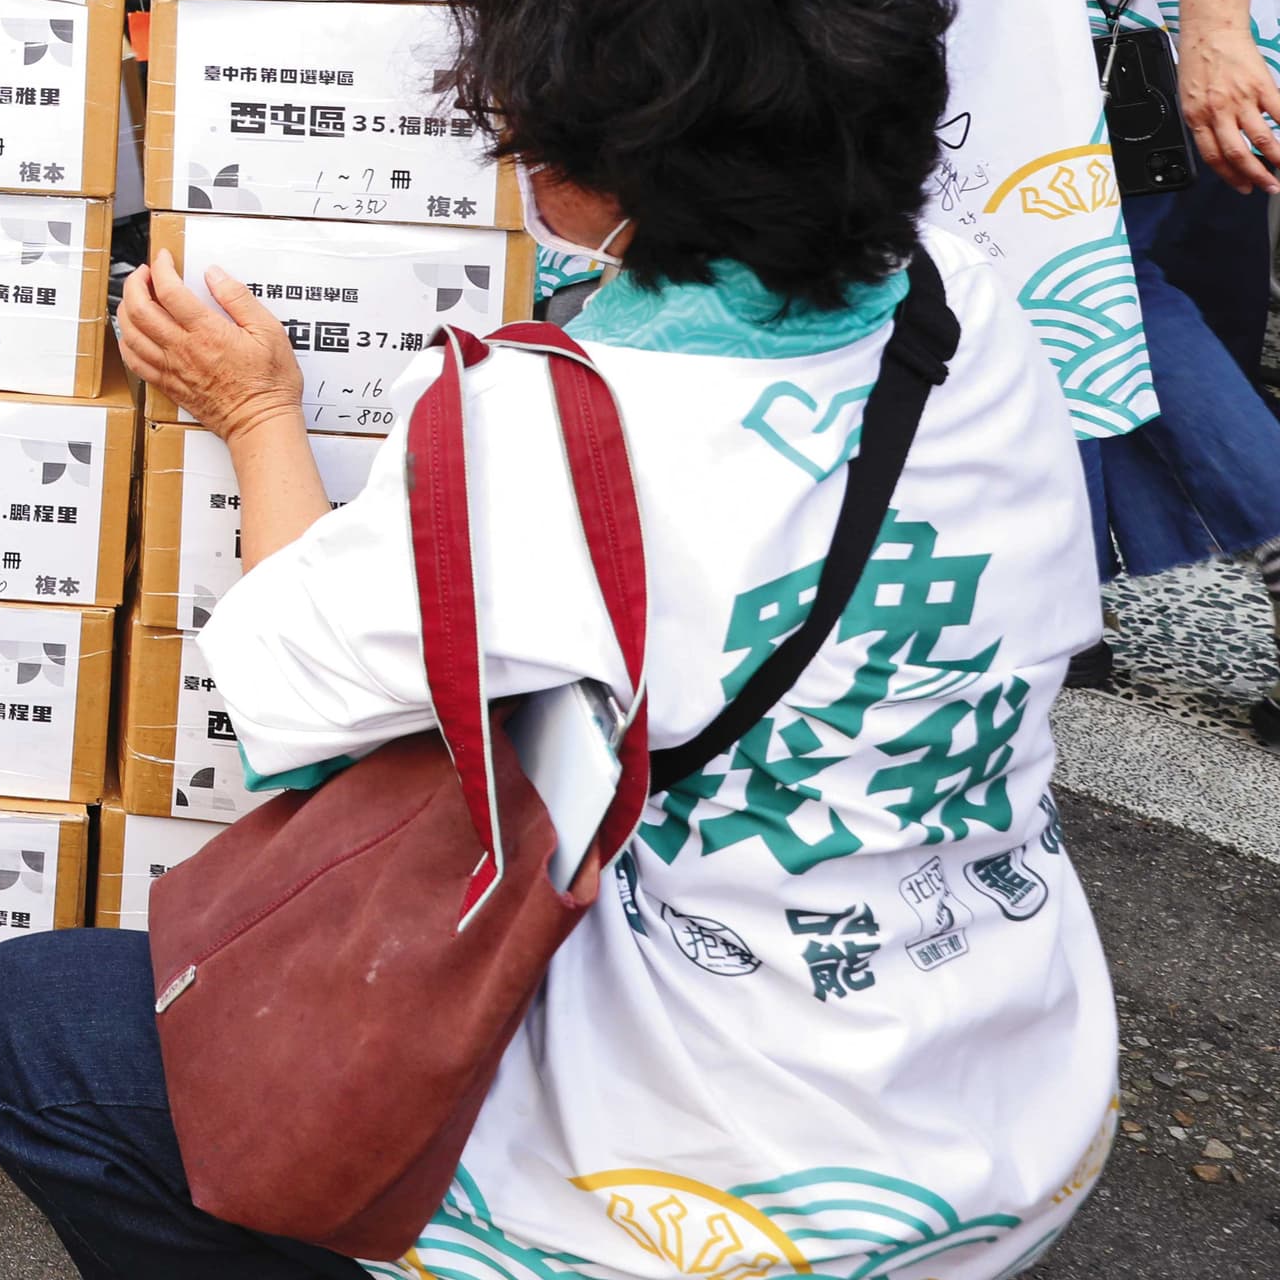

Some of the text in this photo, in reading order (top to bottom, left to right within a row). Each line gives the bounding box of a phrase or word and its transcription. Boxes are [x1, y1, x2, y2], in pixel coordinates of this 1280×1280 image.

[204, 65, 354, 87] 臺中市第四選舉區
[19, 161, 65, 184] 複本
[427, 195, 477, 219] 複本
[35, 575, 80, 597] 複本
